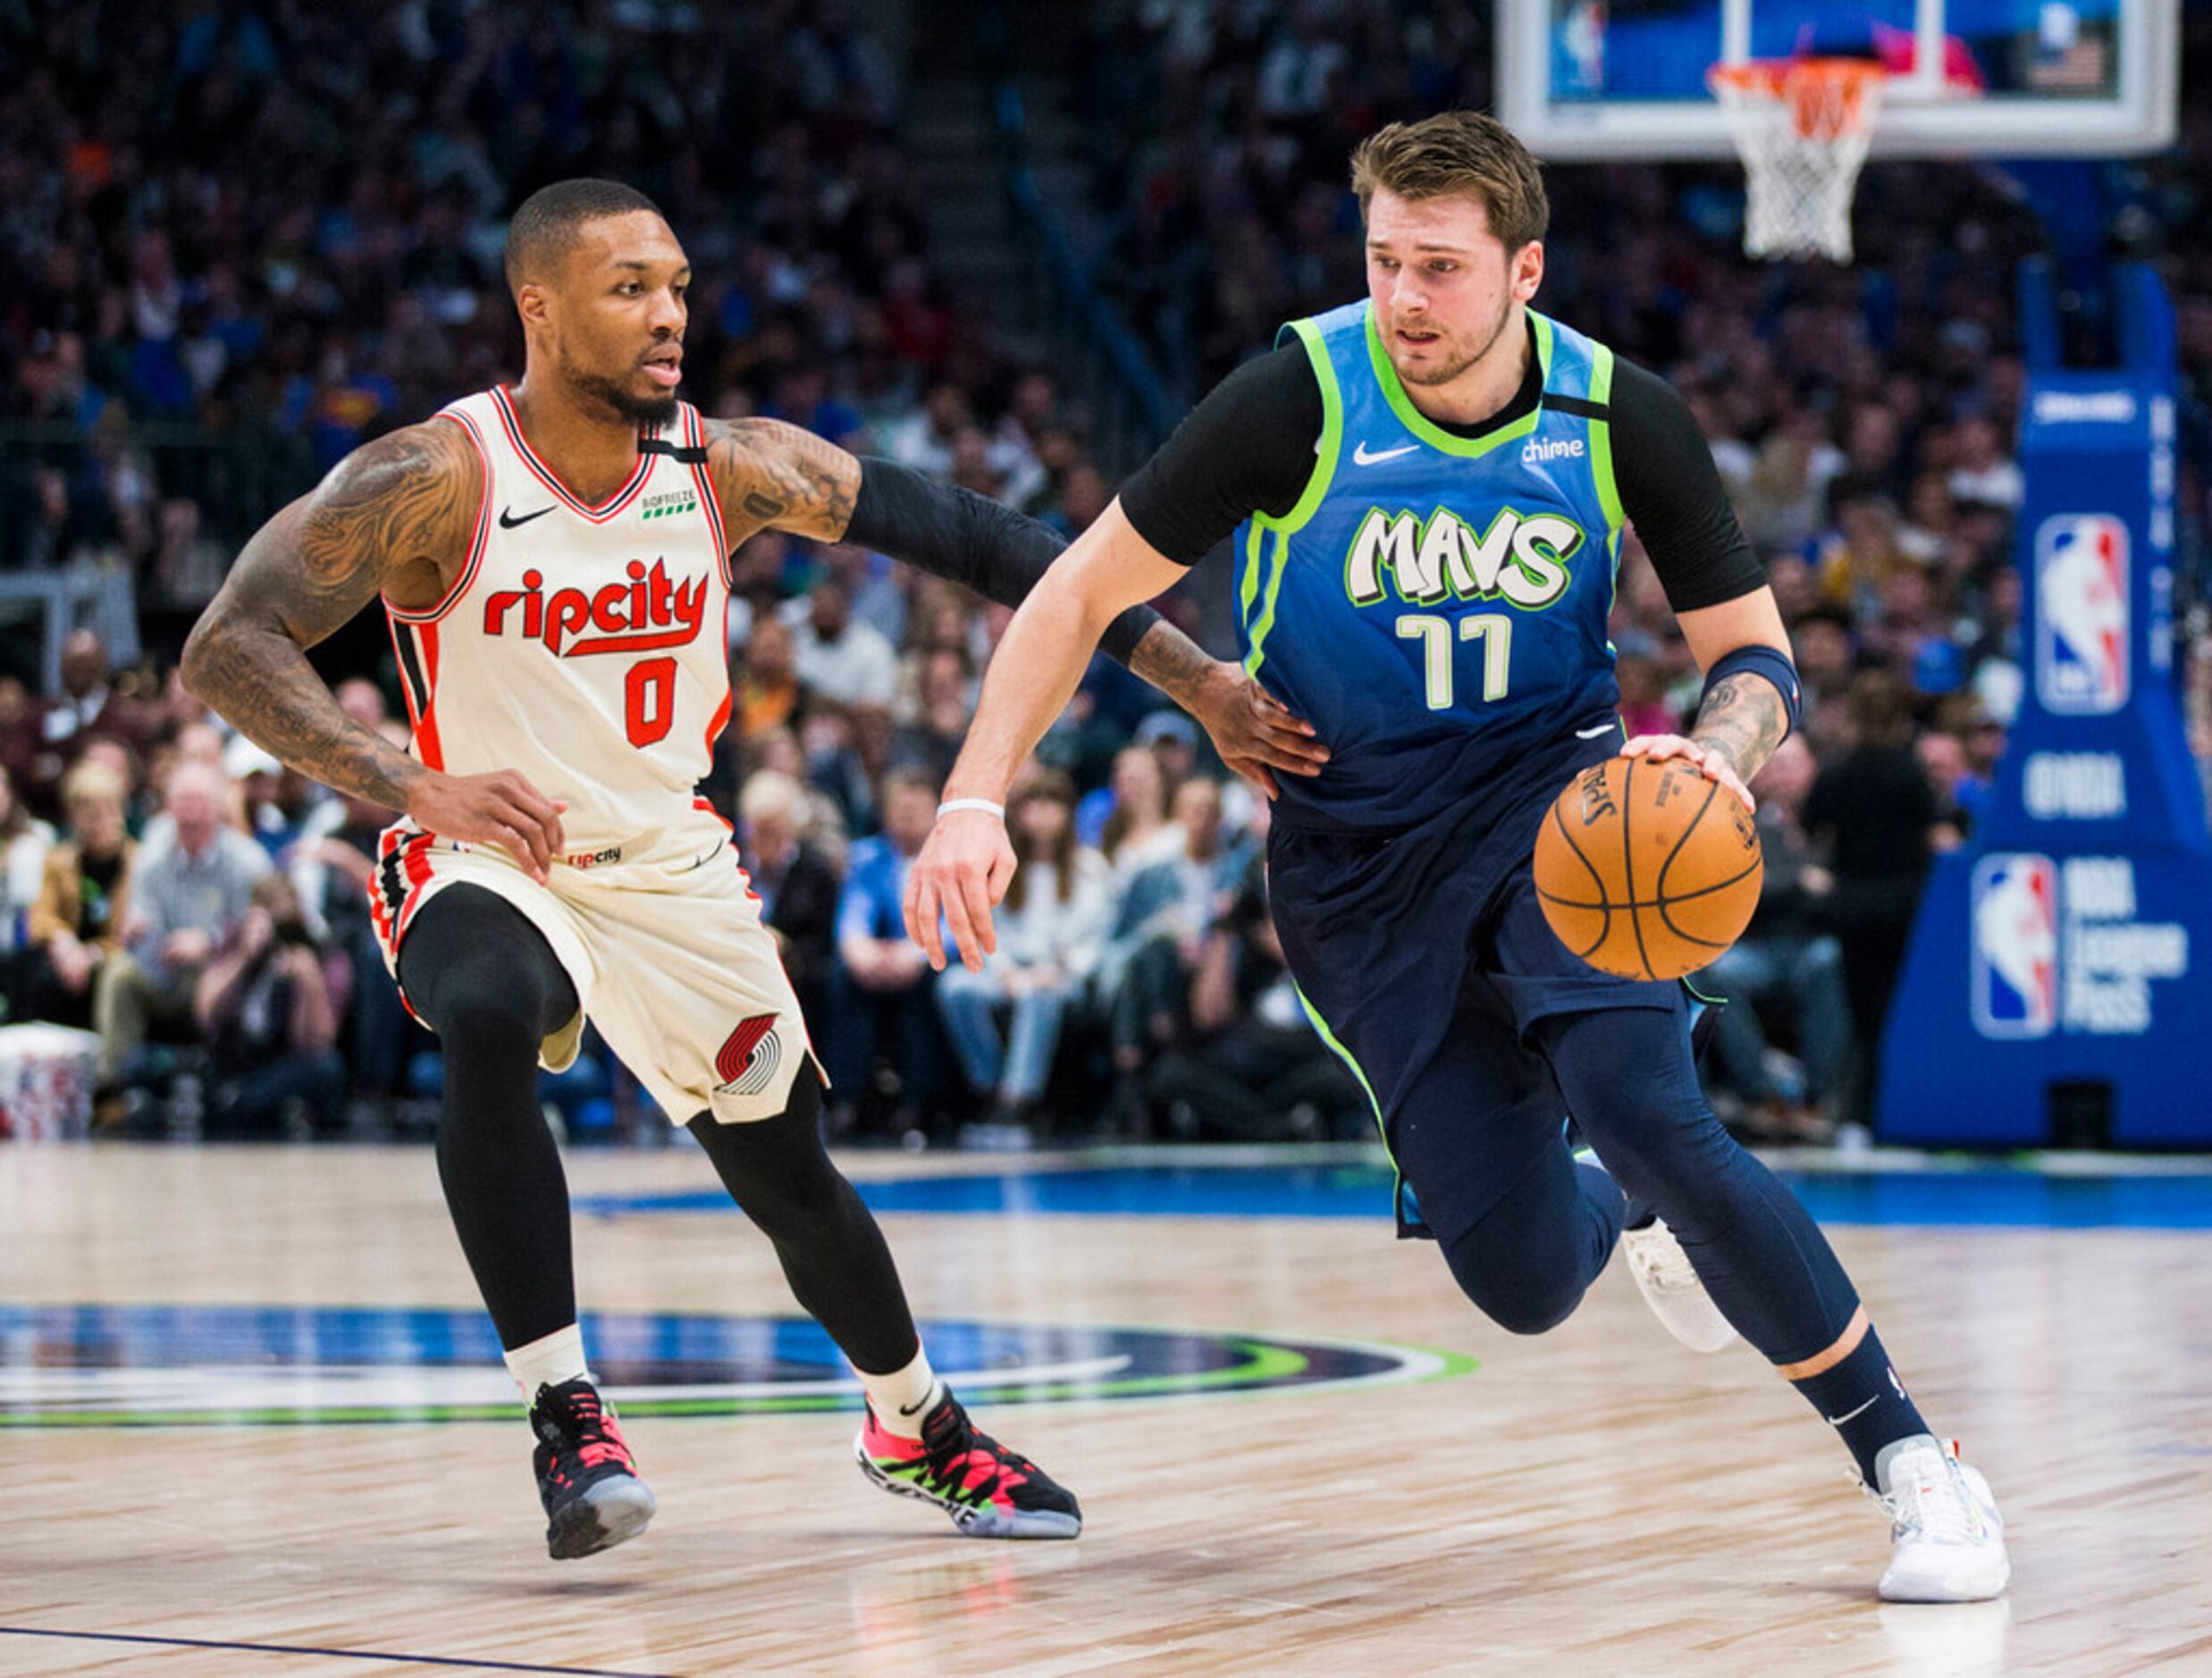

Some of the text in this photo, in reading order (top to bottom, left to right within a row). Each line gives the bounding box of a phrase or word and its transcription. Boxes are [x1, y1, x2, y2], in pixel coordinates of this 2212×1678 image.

[1522, 437, 1584, 463] chime
[1344, 506, 1586, 611] MAVS
[484, 556, 710, 658] ripcity
[625, 656, 677, 750] 0
[1395, 614, 1512, 710] 77
